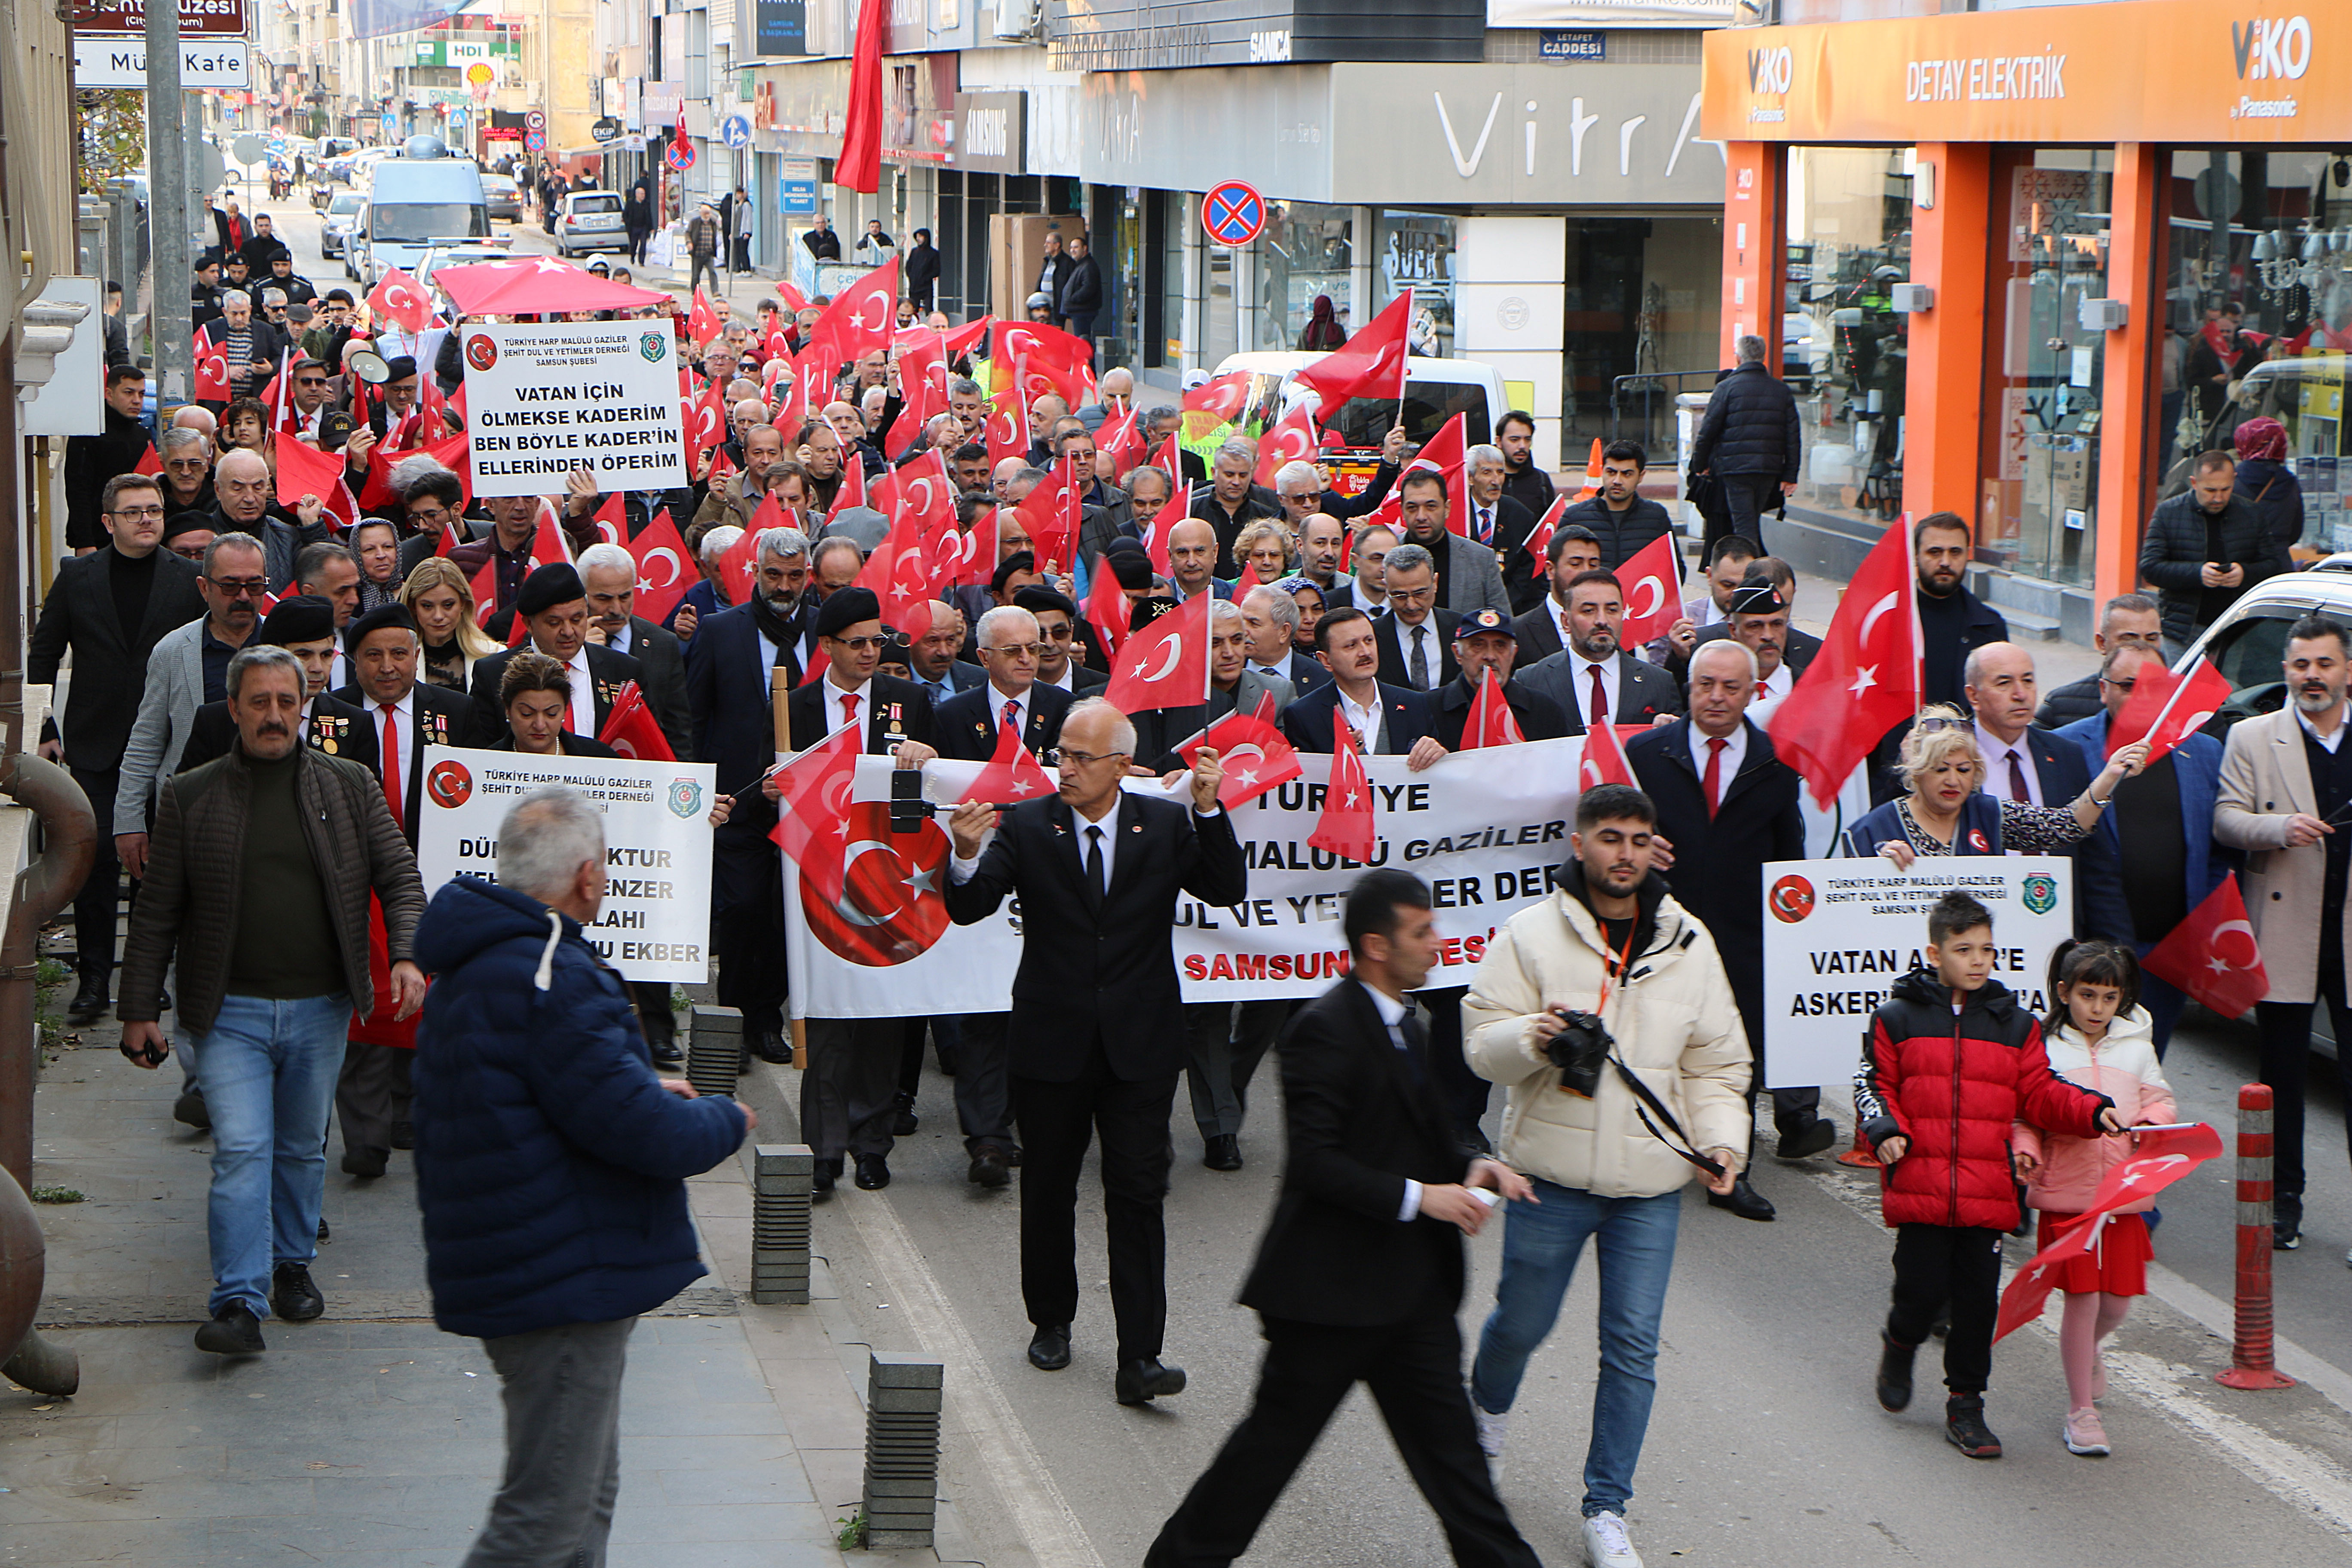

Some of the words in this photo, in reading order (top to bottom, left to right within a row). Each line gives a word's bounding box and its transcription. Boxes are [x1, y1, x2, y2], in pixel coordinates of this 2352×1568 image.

[455, 46, 481, 56] HDI
[1544, 43, 1601, 54] CADDESİ
[186, 54, 240, 71] Kafe
[1907, 59, 1966, 101] DETAY
[1969, 43, 2067, 100] ELEKTRİK
[2240, 94, 2298, 118] Panasonic
[967, 108, 1006, 156] SAMSUNG
[504, 349, 525, 357] ŞEHİT
[557, 347, 594, 355] YETİMLER
[596, 345, 630, 354] DERNEĞİ
[505, 337, 537, 346] TÜRKİYE
[561, 336, 592, 345] MALÜLÜ
[570, 356, 597, 366] ŞUBESİ
[515, 386, 576, 401] VATAN
[584, 381, 623, 402] İÇİN
[482, 409, 570, 426] ÖLMEKSE
[576, 403, 666, 423] KADERİM
[475, 437, 510, 451] BEN
[518, 430, 578, 450] BÖYLE
[479, 456, 594, 475] ELLERİNDEN
[602, 450, 677, 471] ÖPERİM
[484, 769, 529, 781] TÜRKİYE
[533, 774, 559, 782] HARP
[564, 775, 604, 786] MALÜLÜ
[609, 777, 652, 788] GAZİLER
[482, 783, 511, 794] ŞEHİT
[609, 790, 654, 802] DERNEĞİ
[1404, 819, 1565, 861] GAZİLER
[607, 848, 671, 868] KTUR
[603, 879, 673, 899] ENZER
[1828, 877, 1876, 888] TÜRKİYE
[1878, 879, 1907, 888] HARP
[1911, 876, 1953, 886] MALÜLÜ
[1957, 874, 2005, 885] GAZİLER
[1825, 891, 1856, 905] ŞEHİT
[1860, 892, 1880, 902] DUL
[1886, 891, 1898, 901] VE
[1872, 905, 1917, 916] SAMSUN
[622, 942, 700, 963] EKBER
[1810, 949, 1897, 975] VATAN
[1184, 949, 1350, 981] SAMSUN
